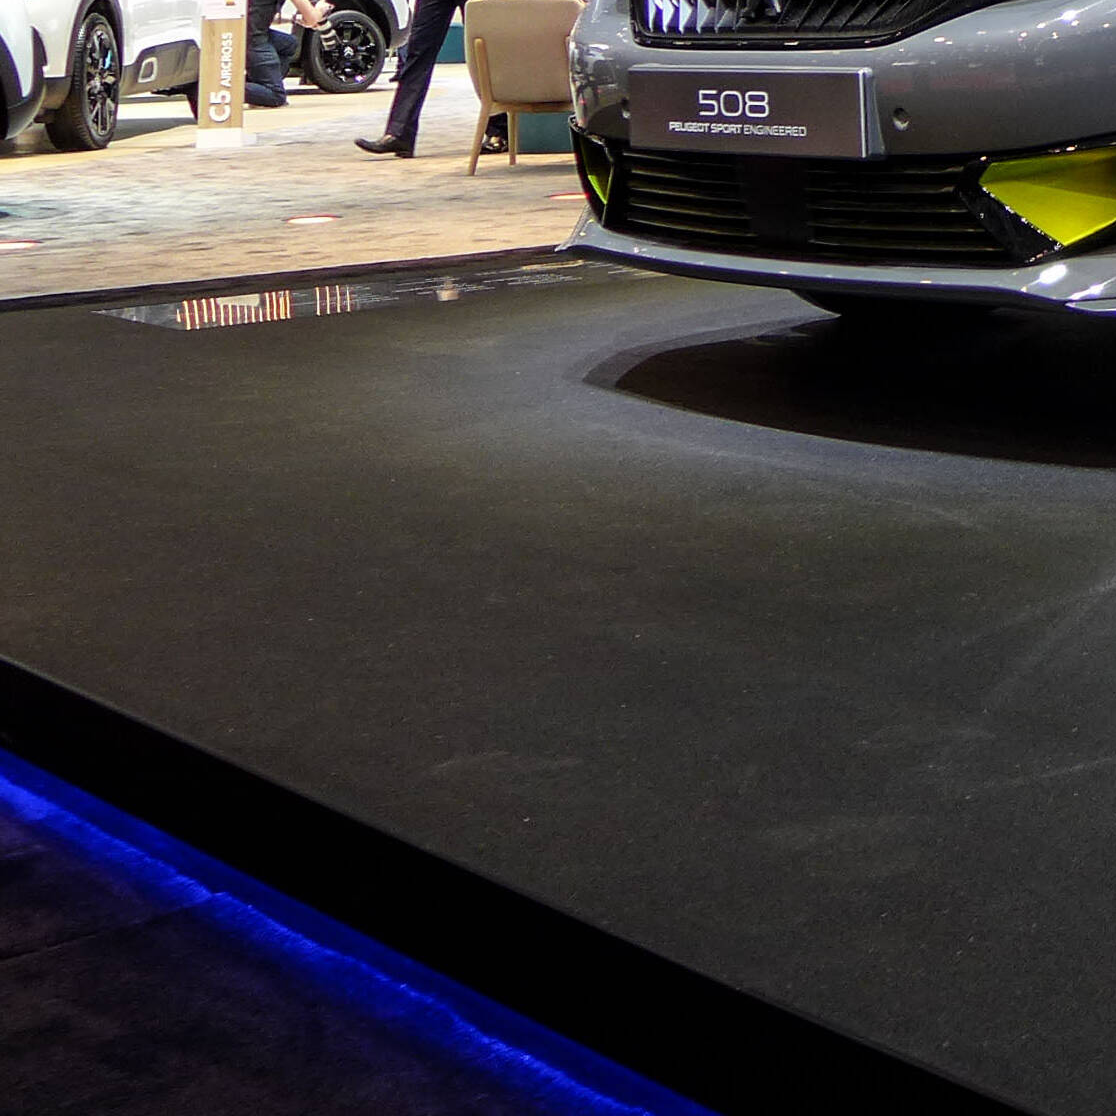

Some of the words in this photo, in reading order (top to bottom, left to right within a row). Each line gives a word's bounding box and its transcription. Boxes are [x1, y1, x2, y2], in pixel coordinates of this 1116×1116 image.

[208, 90, 232, 123] C5
[220, 31, 234, 88] AIRCROSS
[698, 89, 770, 118] 508
[668, 121, 710, 133] PEUGEOT
[710, 123, 743, 135] SPORT
[743, 124, 807, 137] ENGINEERED
